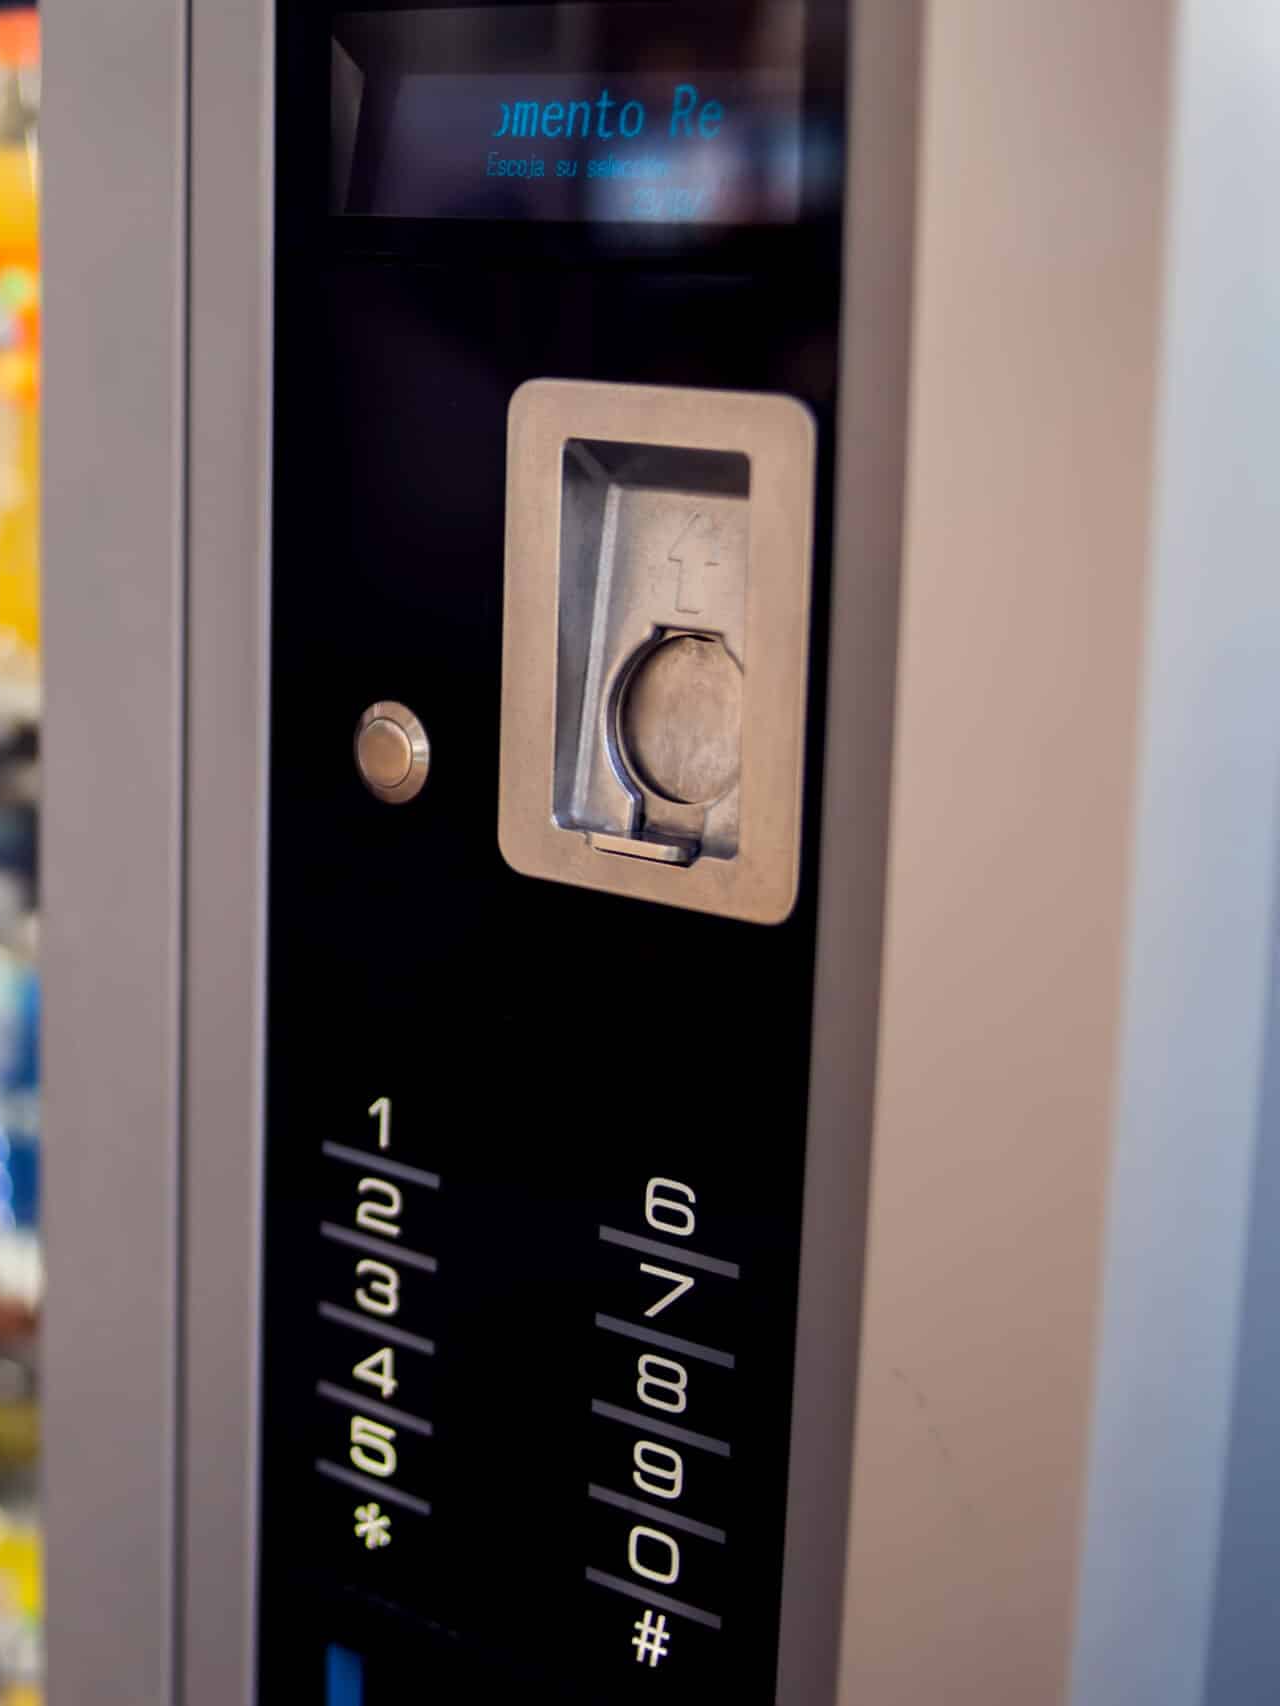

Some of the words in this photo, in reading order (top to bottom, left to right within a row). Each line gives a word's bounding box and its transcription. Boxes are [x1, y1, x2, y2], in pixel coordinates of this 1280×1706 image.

[669, 83, 724, 139] Re
[486, 152, 545, 178] Escoja
[555, 160, 577, 177] su
[368, 1097, 391, 1149] 1
[356, 1177, 402, 1237] 2
[644, 1176, 697, 1237] 6
[355, 1259, 399, 1316] 3
[639, 1262, 696, 1318] 7
[352, 1347, 397, 1399] 4
[636, 1353, 689, 1414] 8
[350, 1415, 397, 1478] 5
[633, 1440, 684, 1500] 9
[628, 1525, 681, 1585] 0
[631, 1609, 671, 1668] #
